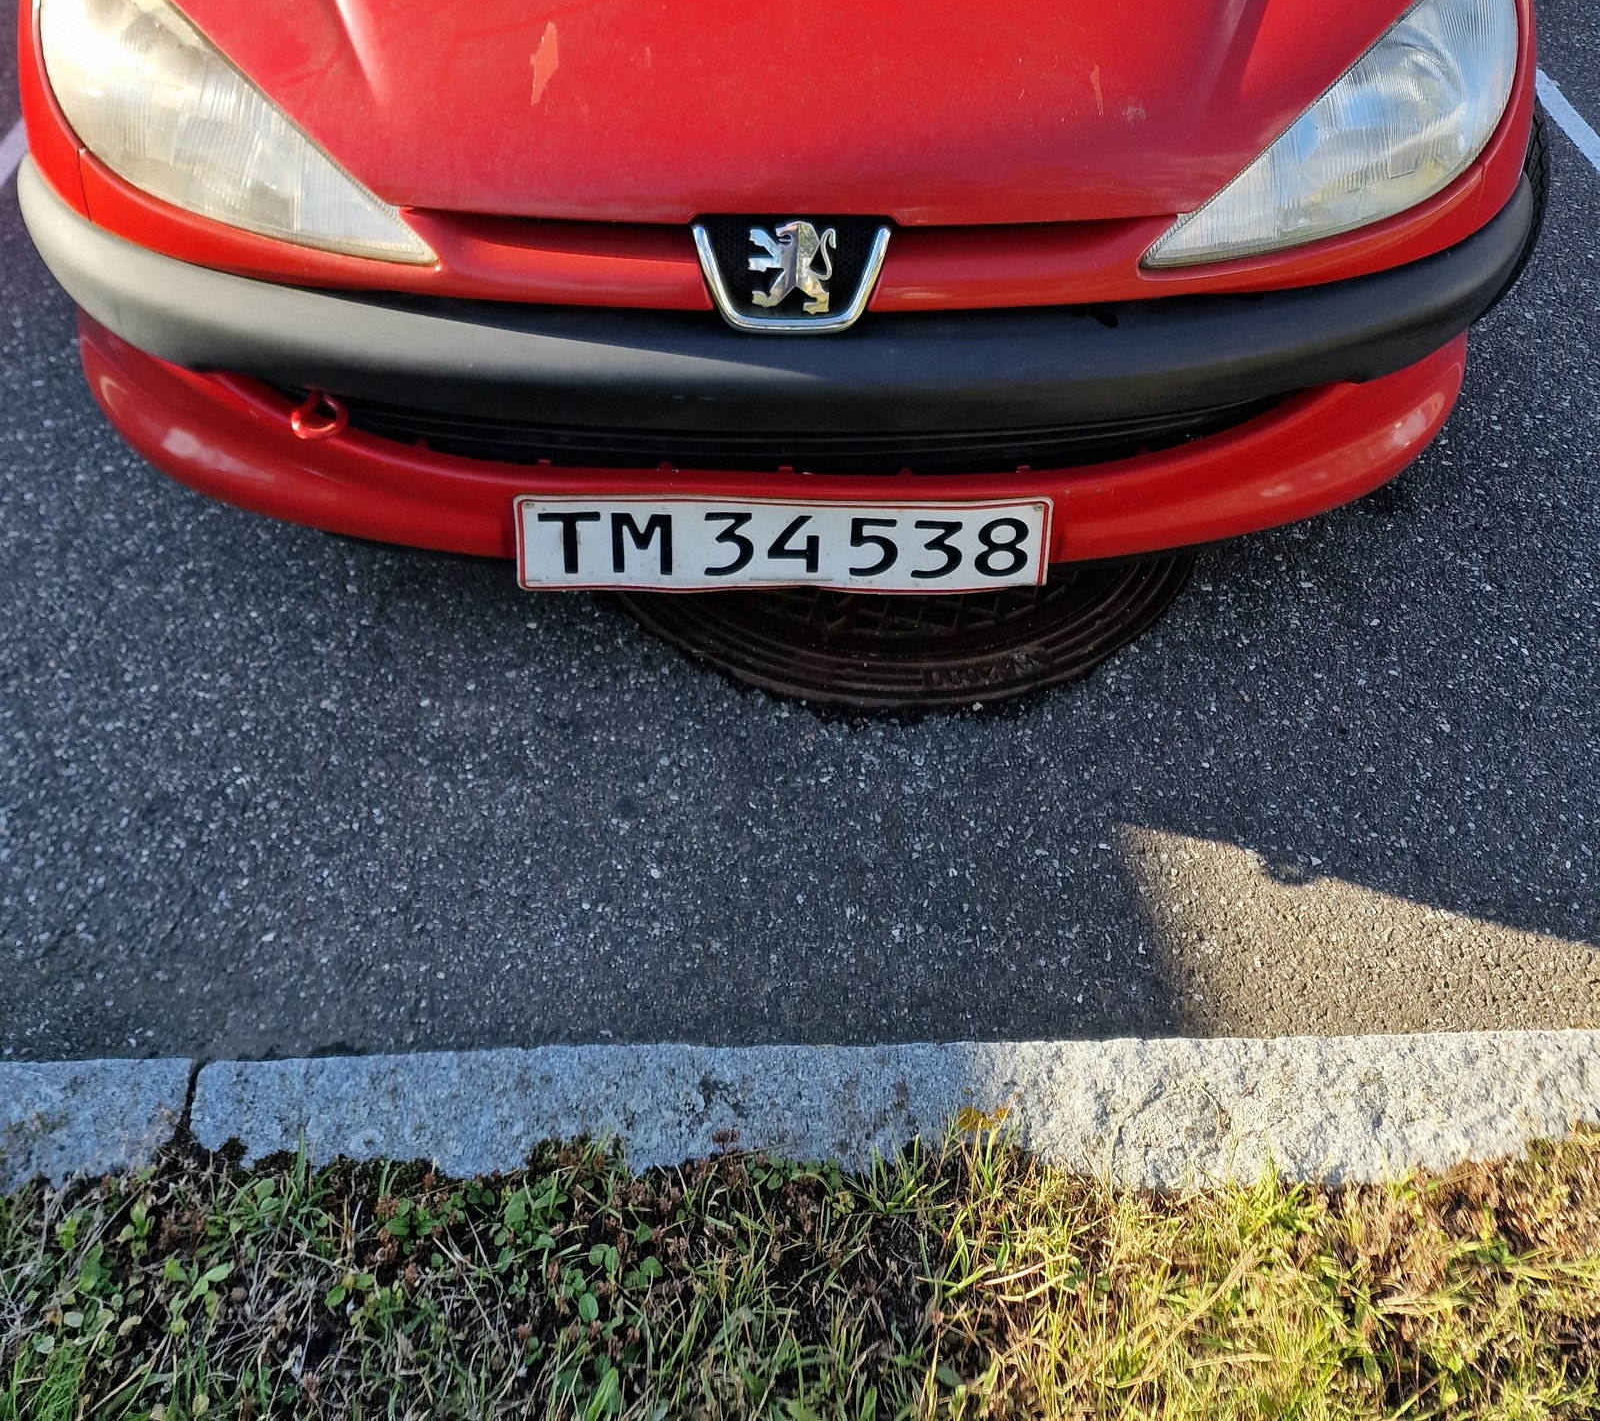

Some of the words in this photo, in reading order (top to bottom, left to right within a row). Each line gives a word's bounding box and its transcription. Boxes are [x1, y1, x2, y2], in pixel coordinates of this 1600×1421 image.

[537, 511, 673, 575] TM
[703, 511, 820, 576] 34
[848, 516, 1030, 579] 538
